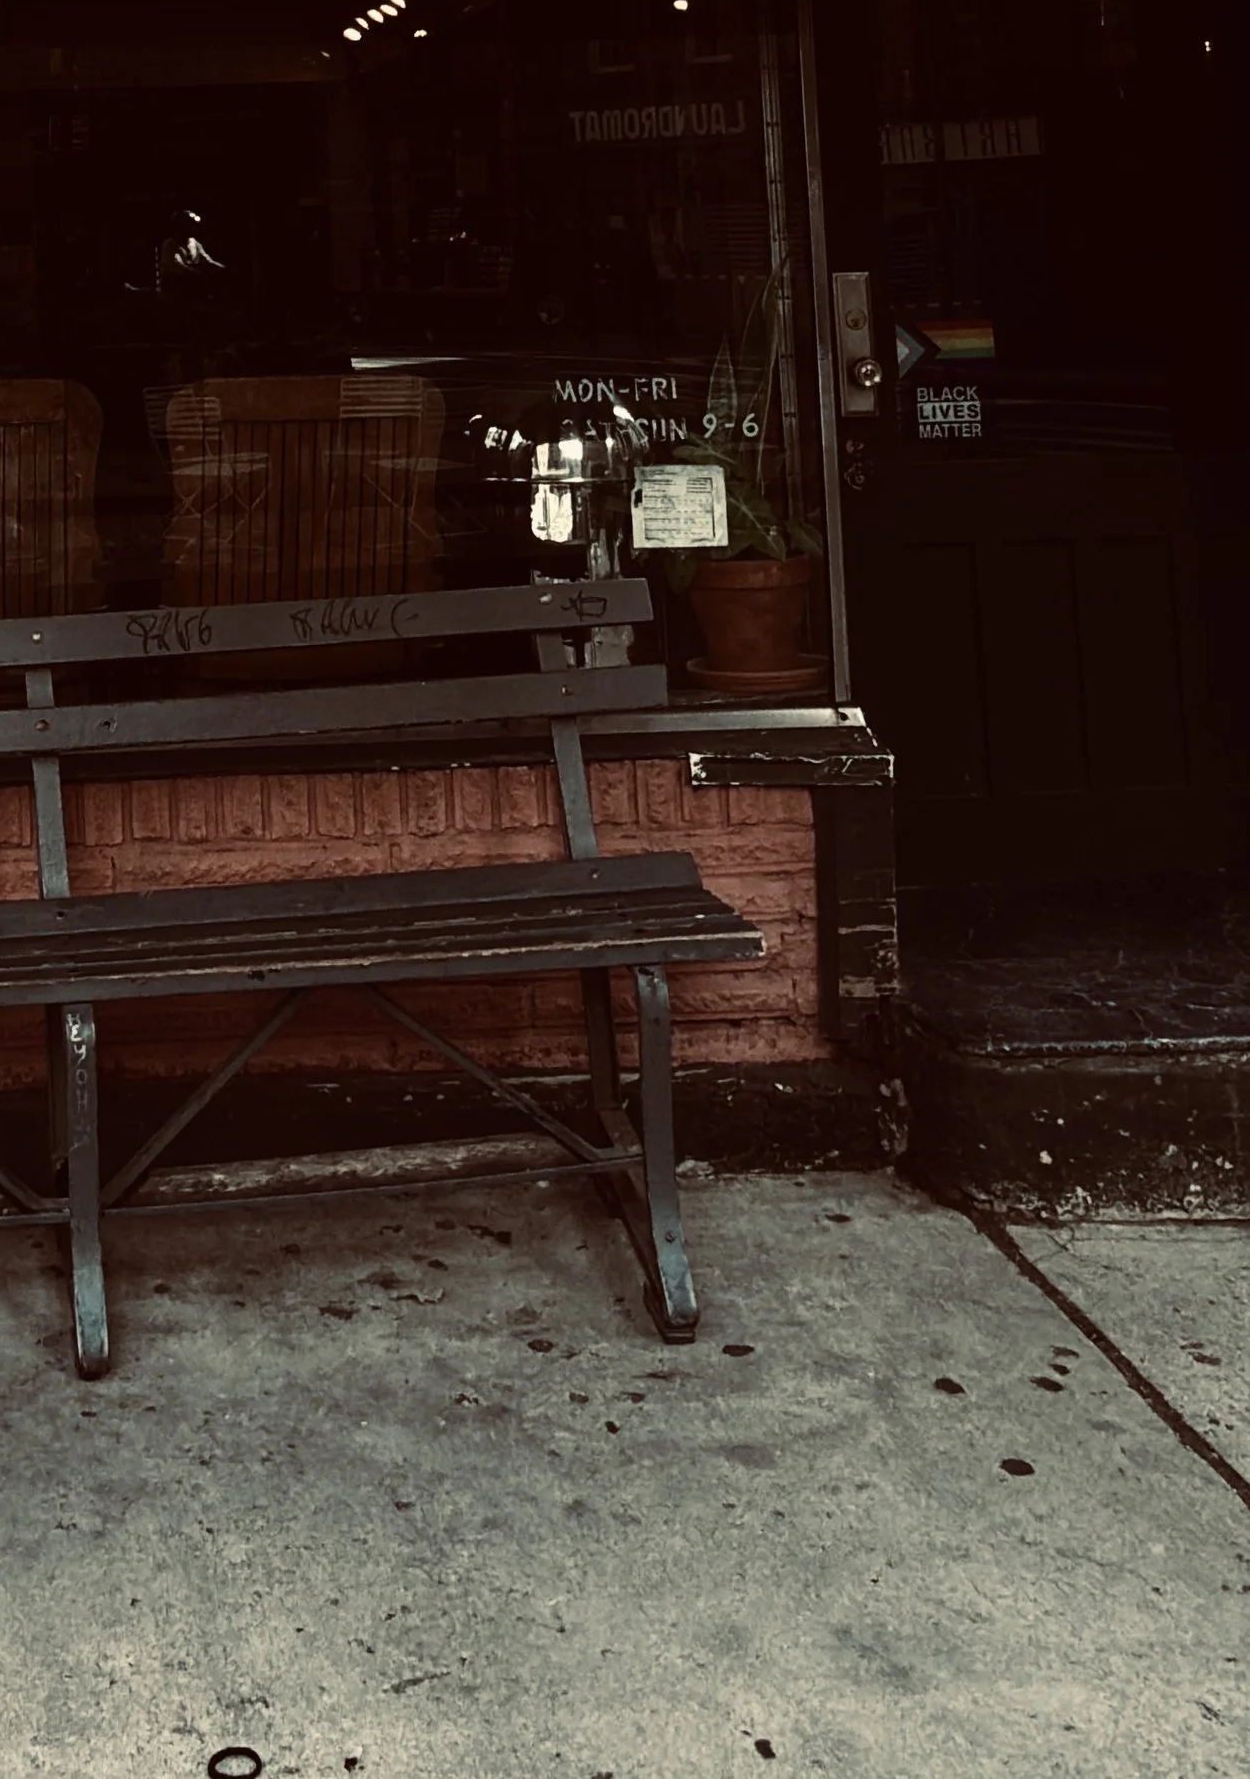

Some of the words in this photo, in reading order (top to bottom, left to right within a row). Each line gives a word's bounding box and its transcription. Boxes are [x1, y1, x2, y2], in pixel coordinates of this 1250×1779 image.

[553, 376, 678, 404] MON-FRI
[916, 385, 979, 402] BLACK
[918, 404, 979, 420] LIVES
[701, 412, 760, 439] 9-6
[918, 423, 983, 439] MATTER
